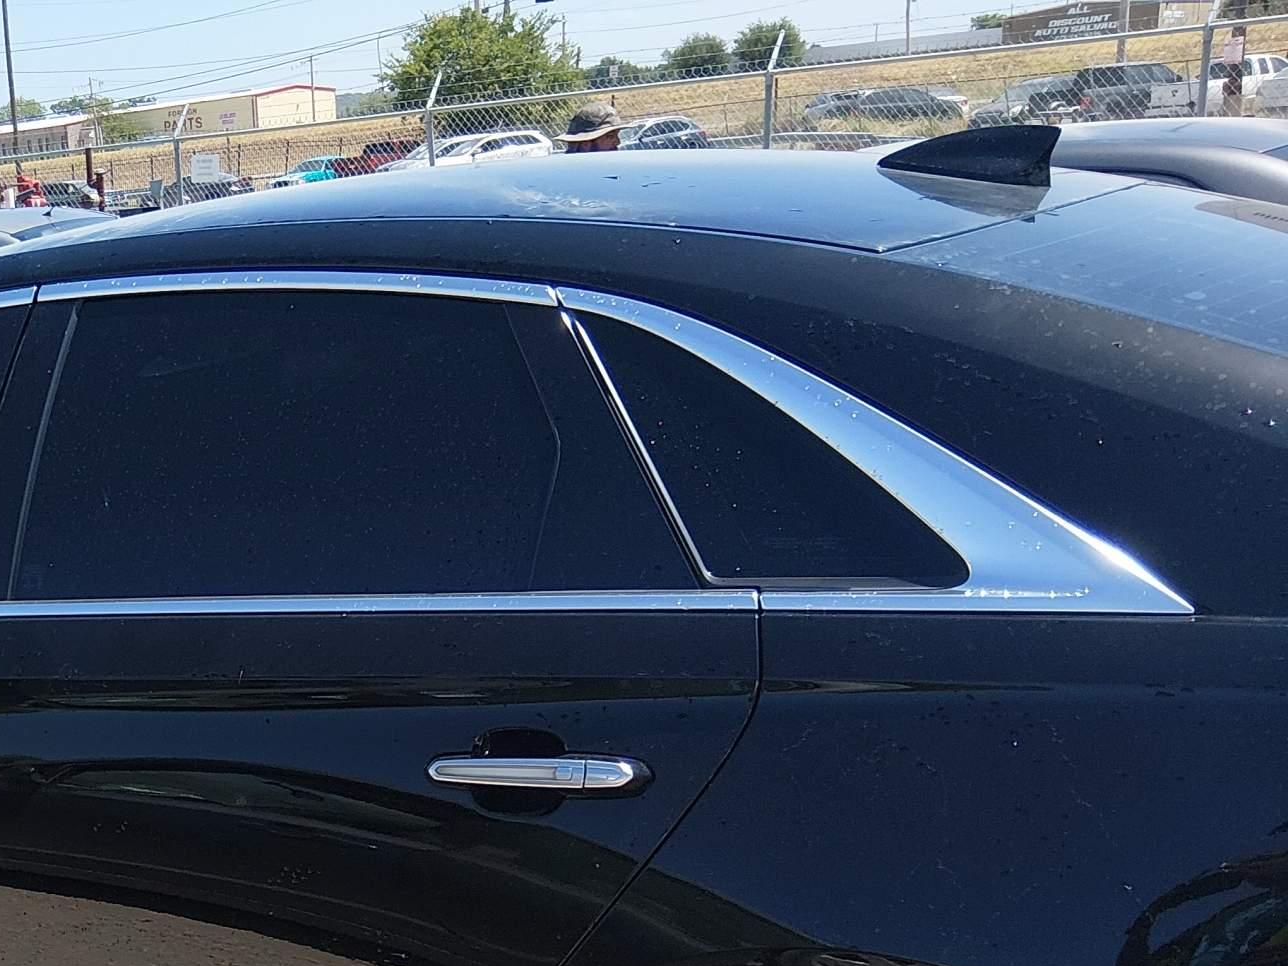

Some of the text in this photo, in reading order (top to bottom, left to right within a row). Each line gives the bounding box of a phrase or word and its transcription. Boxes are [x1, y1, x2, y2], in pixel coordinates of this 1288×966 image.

[1066, 3, 1092, 15] ALL
[1048, 13, 1113, 28] DISCOUNT
[1034, 26, 1069, 37] AUTO
[1071, 20, 1118, 33] SALVAG
